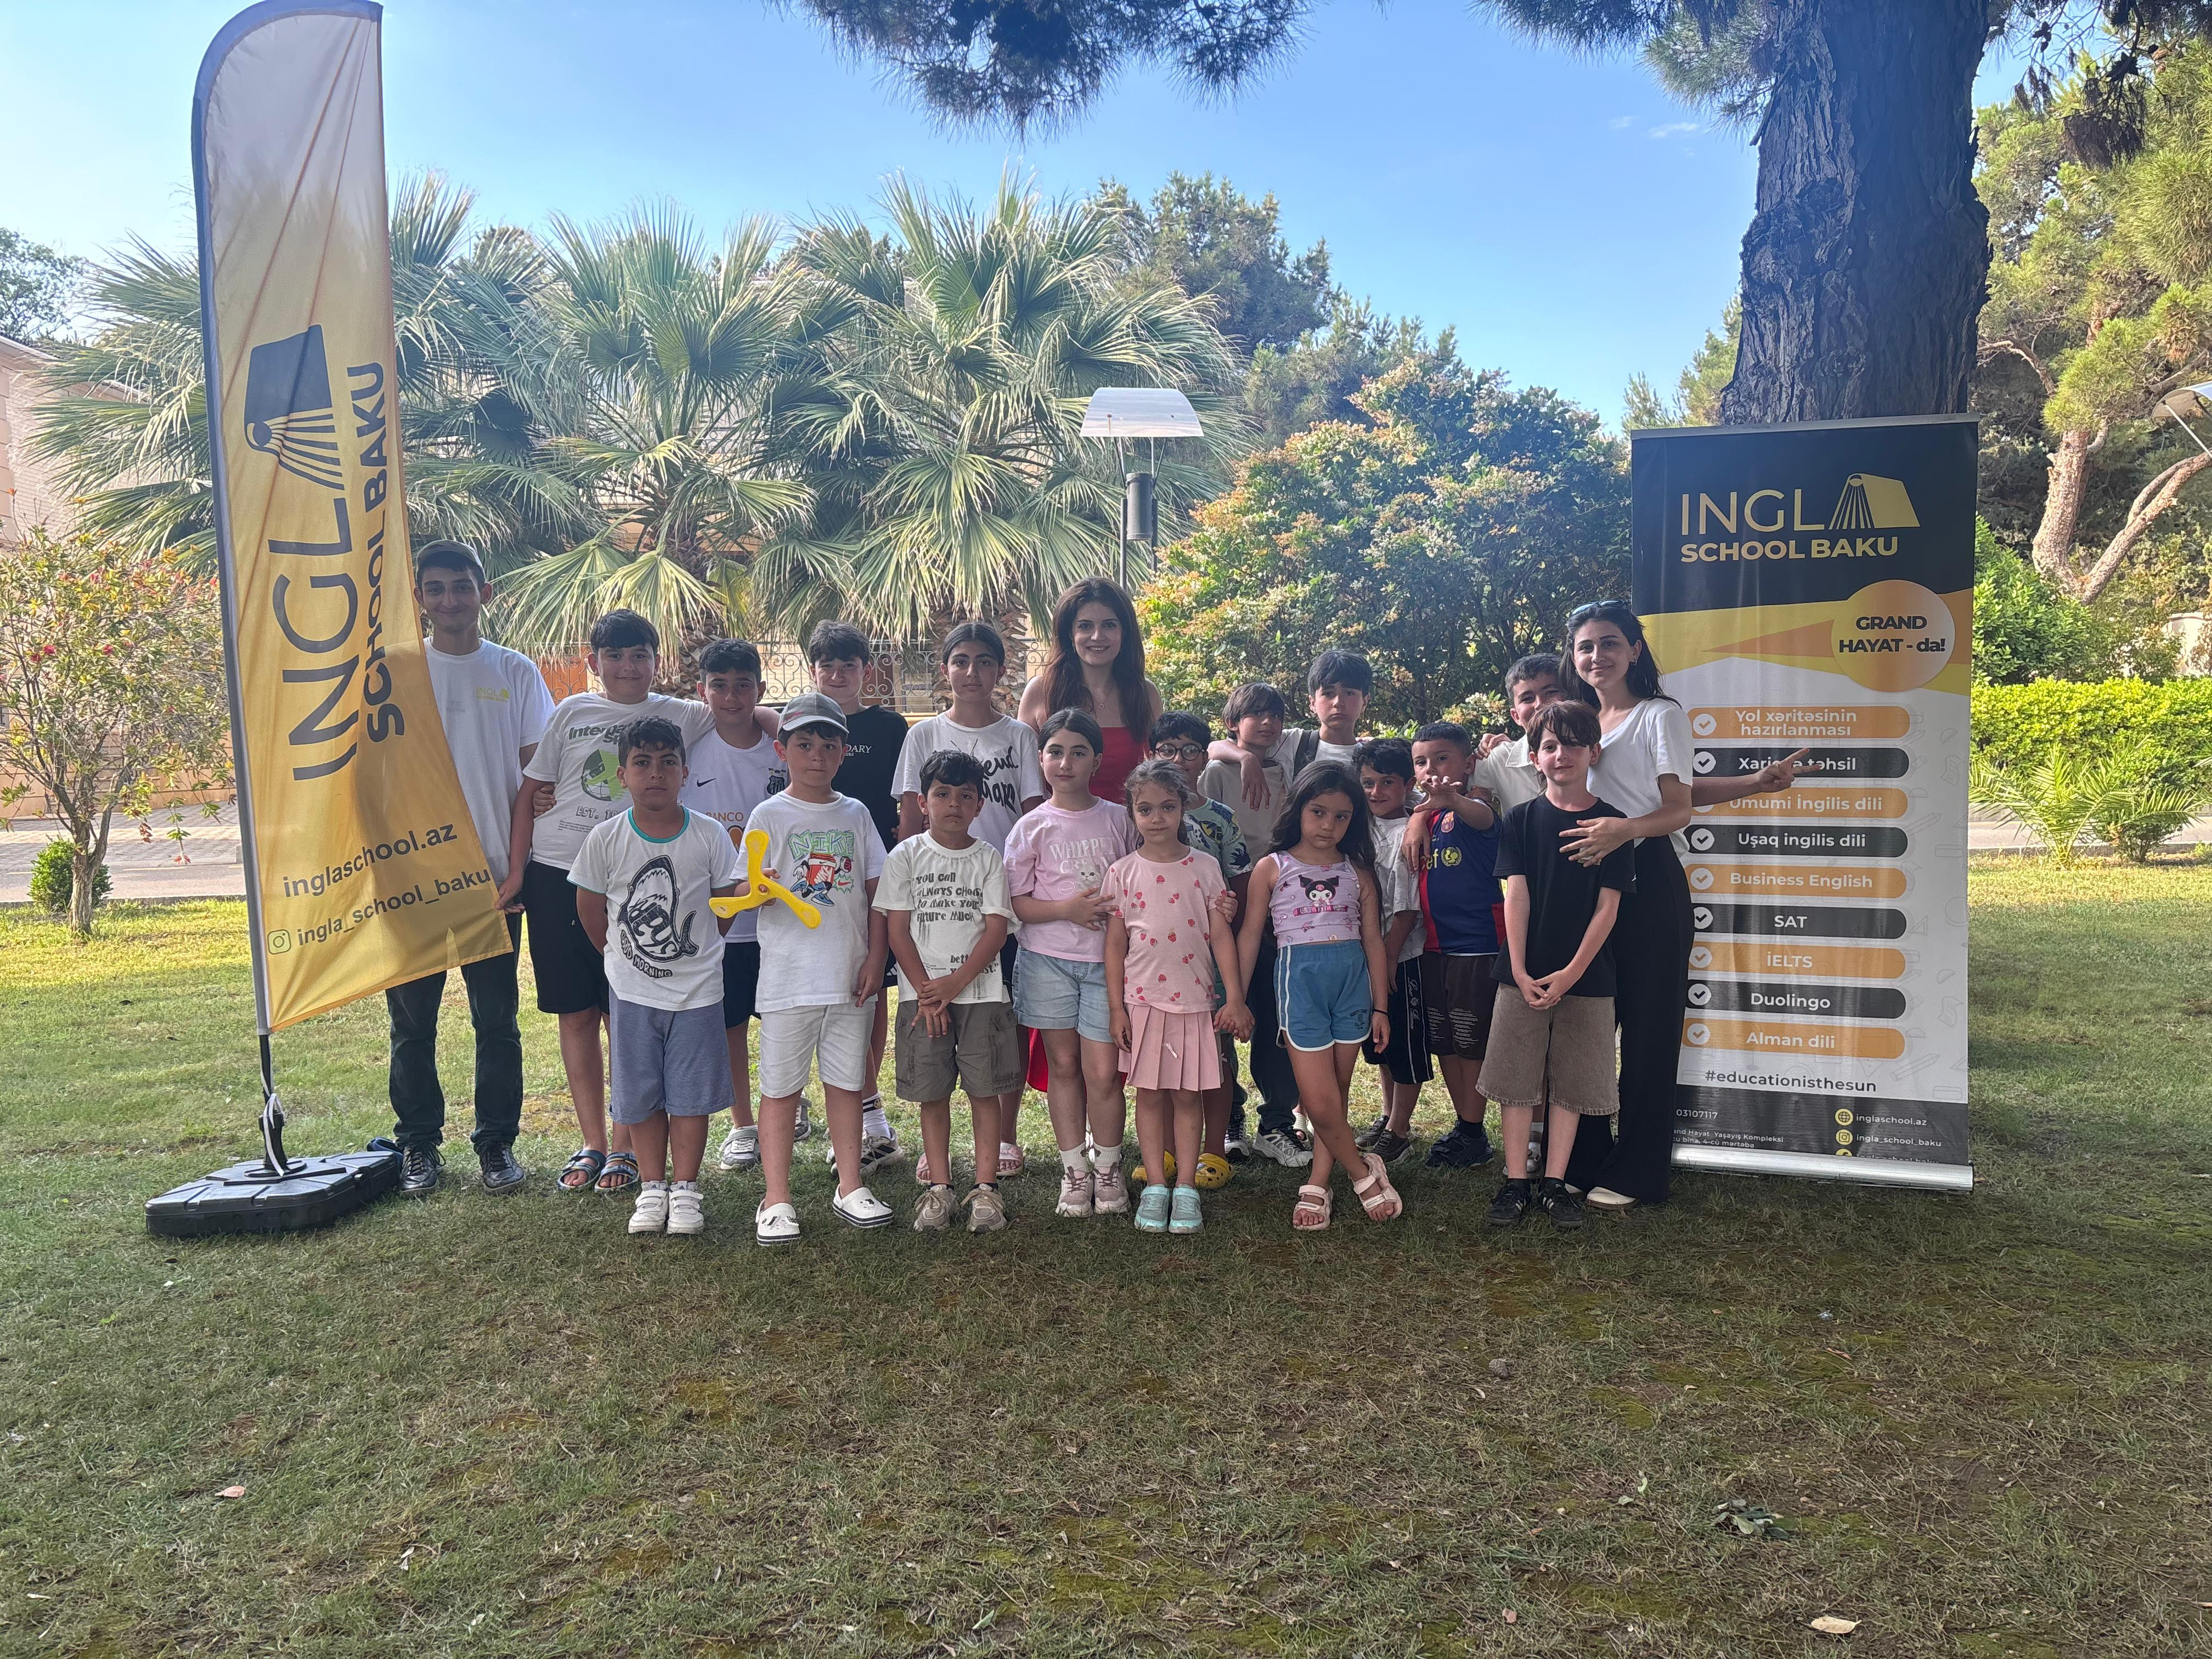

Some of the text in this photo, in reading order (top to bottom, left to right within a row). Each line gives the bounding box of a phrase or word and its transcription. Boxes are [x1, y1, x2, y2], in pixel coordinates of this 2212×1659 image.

[347, 362, 404, 742] SCHOOL BAKU
[1681, 536, 1898, 563] SCHOOL BAKU
[1855, 615, 1927, 630] GRAND
[1839, 639, 1903, 653] HAYAT
[1916, 638, 1945, 653] da!
[1735, 709, 1857, 722] Yol xəritəsinin
[1741, 723, 1850, 736] hazırlanması
[1738, 756, 1857, 770] Xariə təhsil
[1855, 797, 1882, 810] dili
[788, 830, 854, 861] NIKE
[1739, 832, 1866, 849] Uşaq ingilis dili
[283, 824, 458, 897] inglaschool.az
[1730, 872, 1872, 890] Business English
[298, 869, 492, 945] ingla_school_baku
[1774, 915, 1808, 928] SAT
[950, 953, 969, 964] bett
[633, 954, 673, 979] MORNING
[1751, 993, 1831, 1011] Duolingo
[1746, 1032, 1835, 1048] Alman dili
[1705, 1070, 1876, 1092] #educationisthesun
[1856, 1114, 1927, 1126] inglaschool.az
[1743, 1133, 1784, 1143] Kompleksi
[1856, 1133, 1942, 1147] ingla_school_baku
